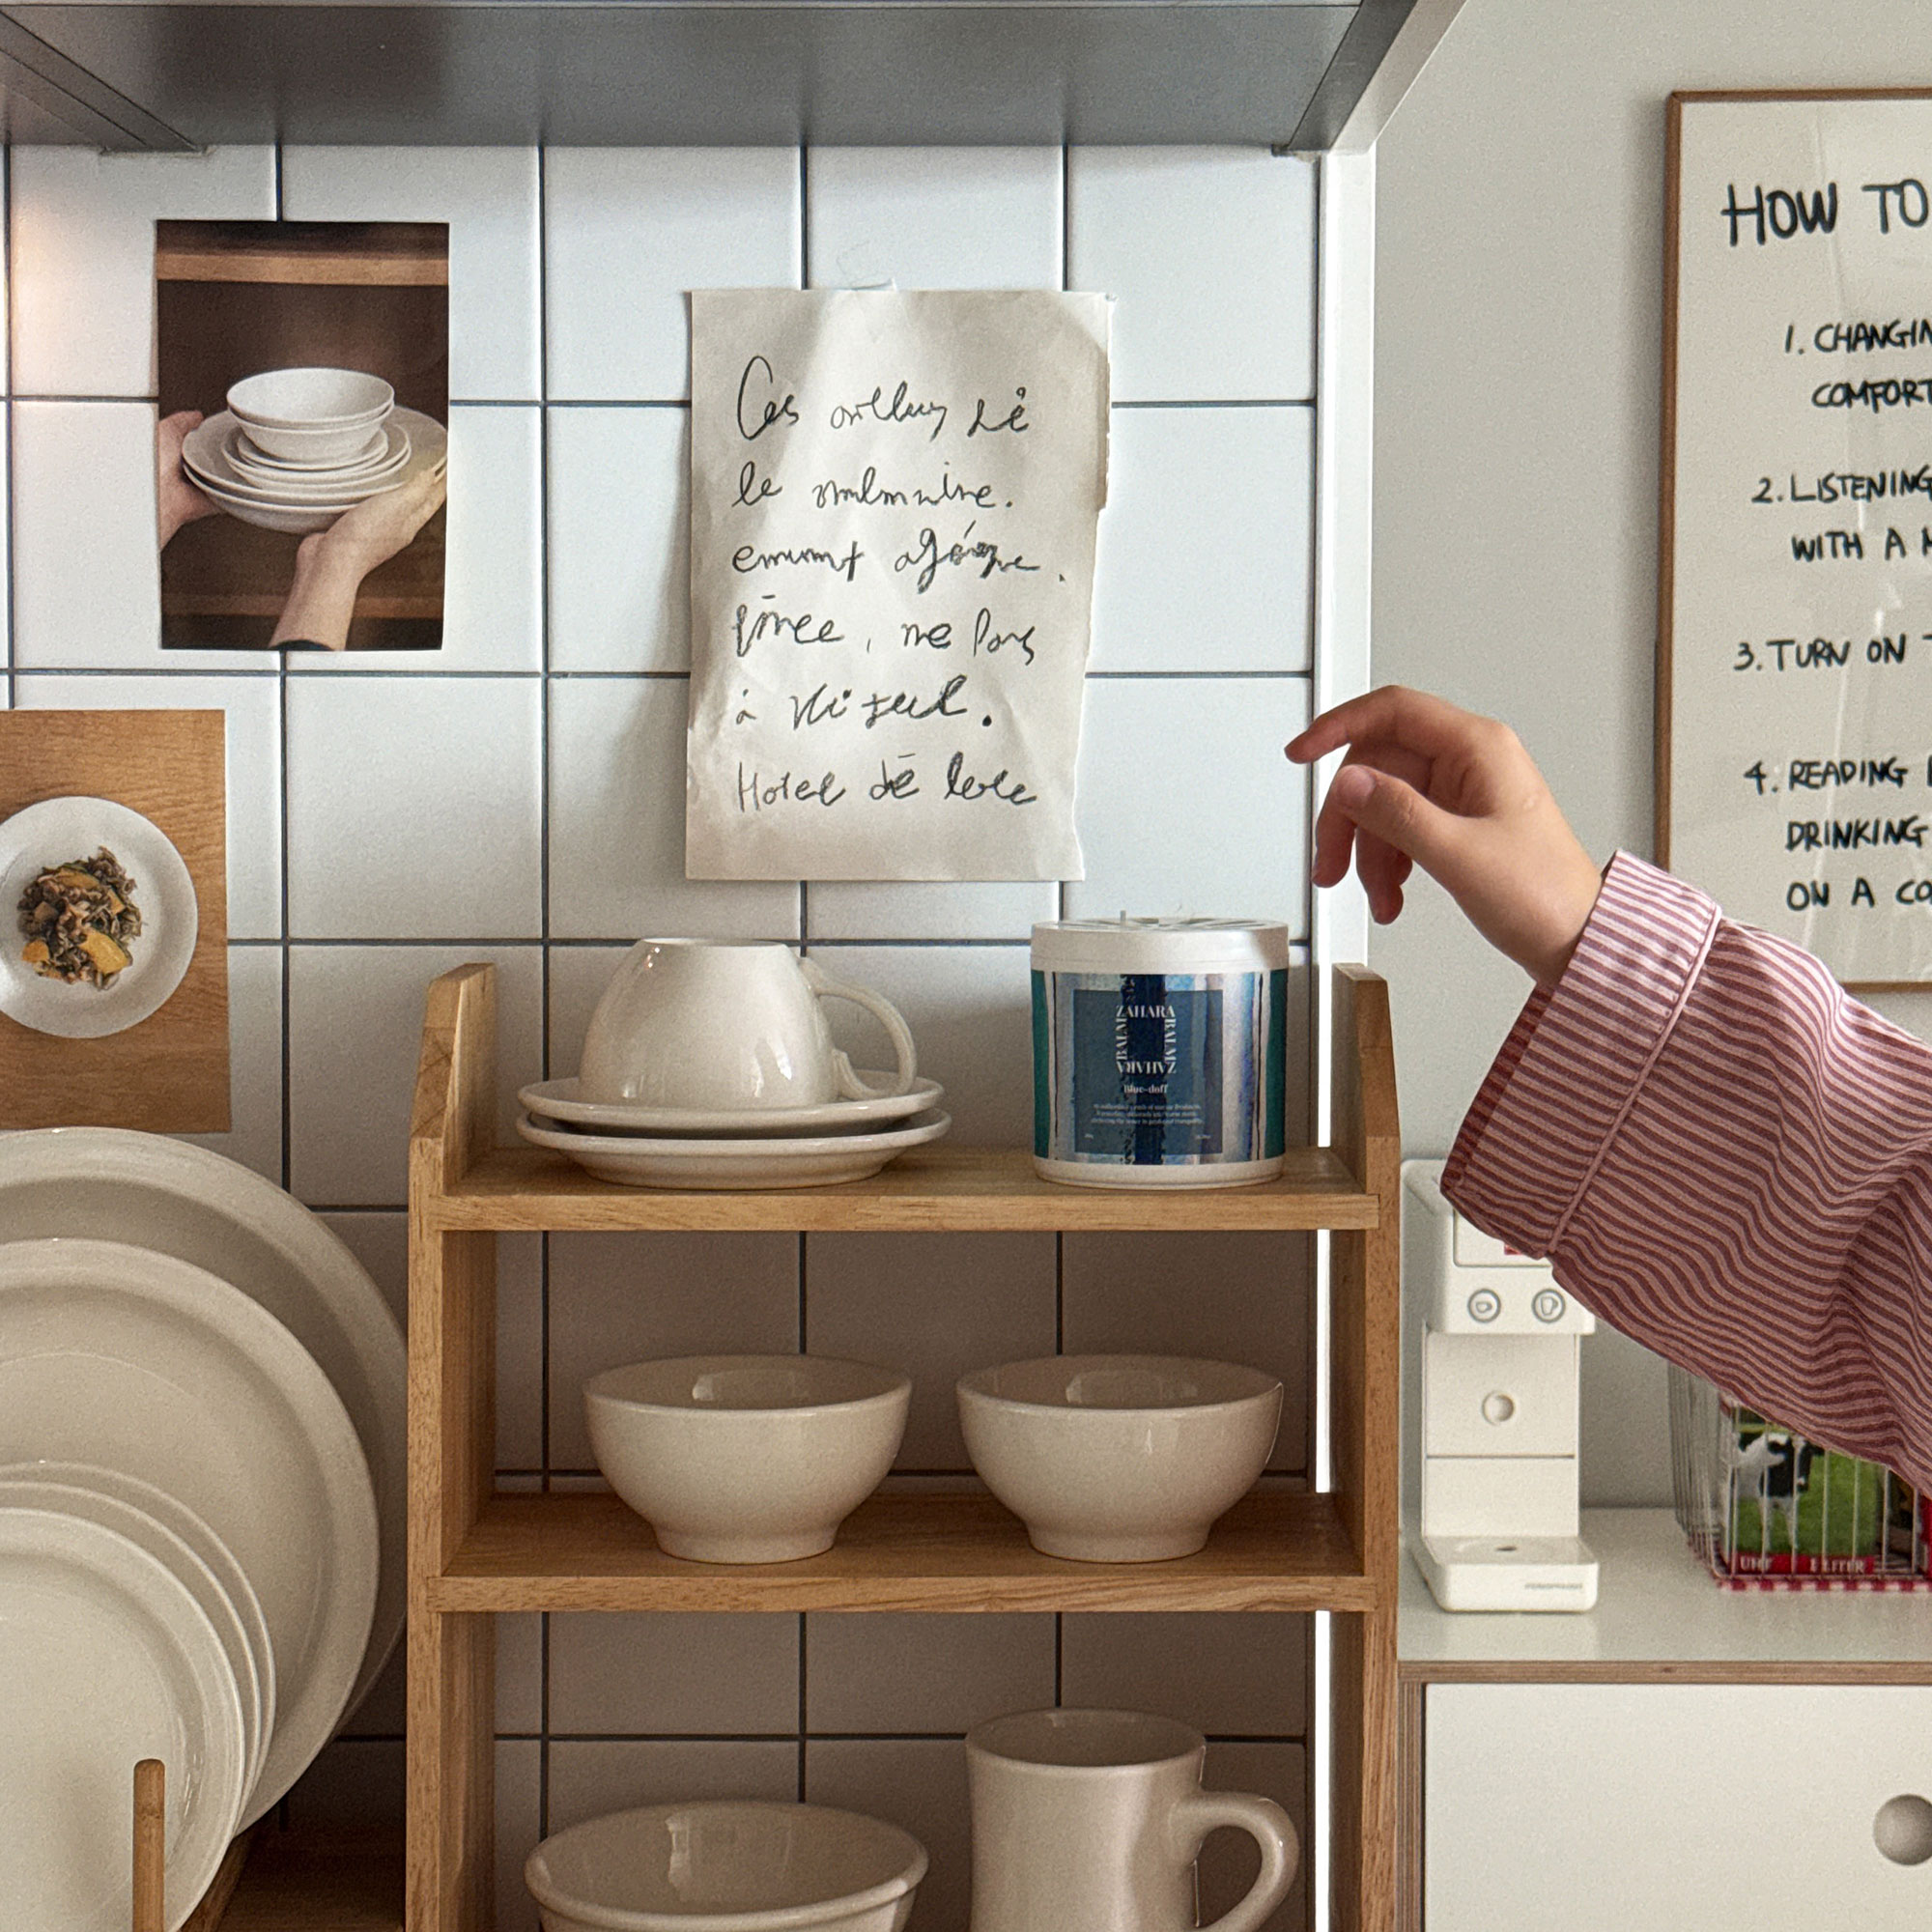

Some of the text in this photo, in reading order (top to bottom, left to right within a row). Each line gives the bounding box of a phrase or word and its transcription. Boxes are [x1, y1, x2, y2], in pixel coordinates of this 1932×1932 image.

[1719, 177, 1931, 247] HOW TO
[1790, 530, 1864, 563] WITH
[1884, 526, 1908, 561] A
[1866, 633, 1908, 665] ON
[1788, 755, 1910, 792] READING
[1784, 814, 1930, 853] DRINKING
[1785, 880, 1831, 912] ON
[1850, 876, 1876, 909] A
[1116, 1005, 1176, 1018] ZAHARA
